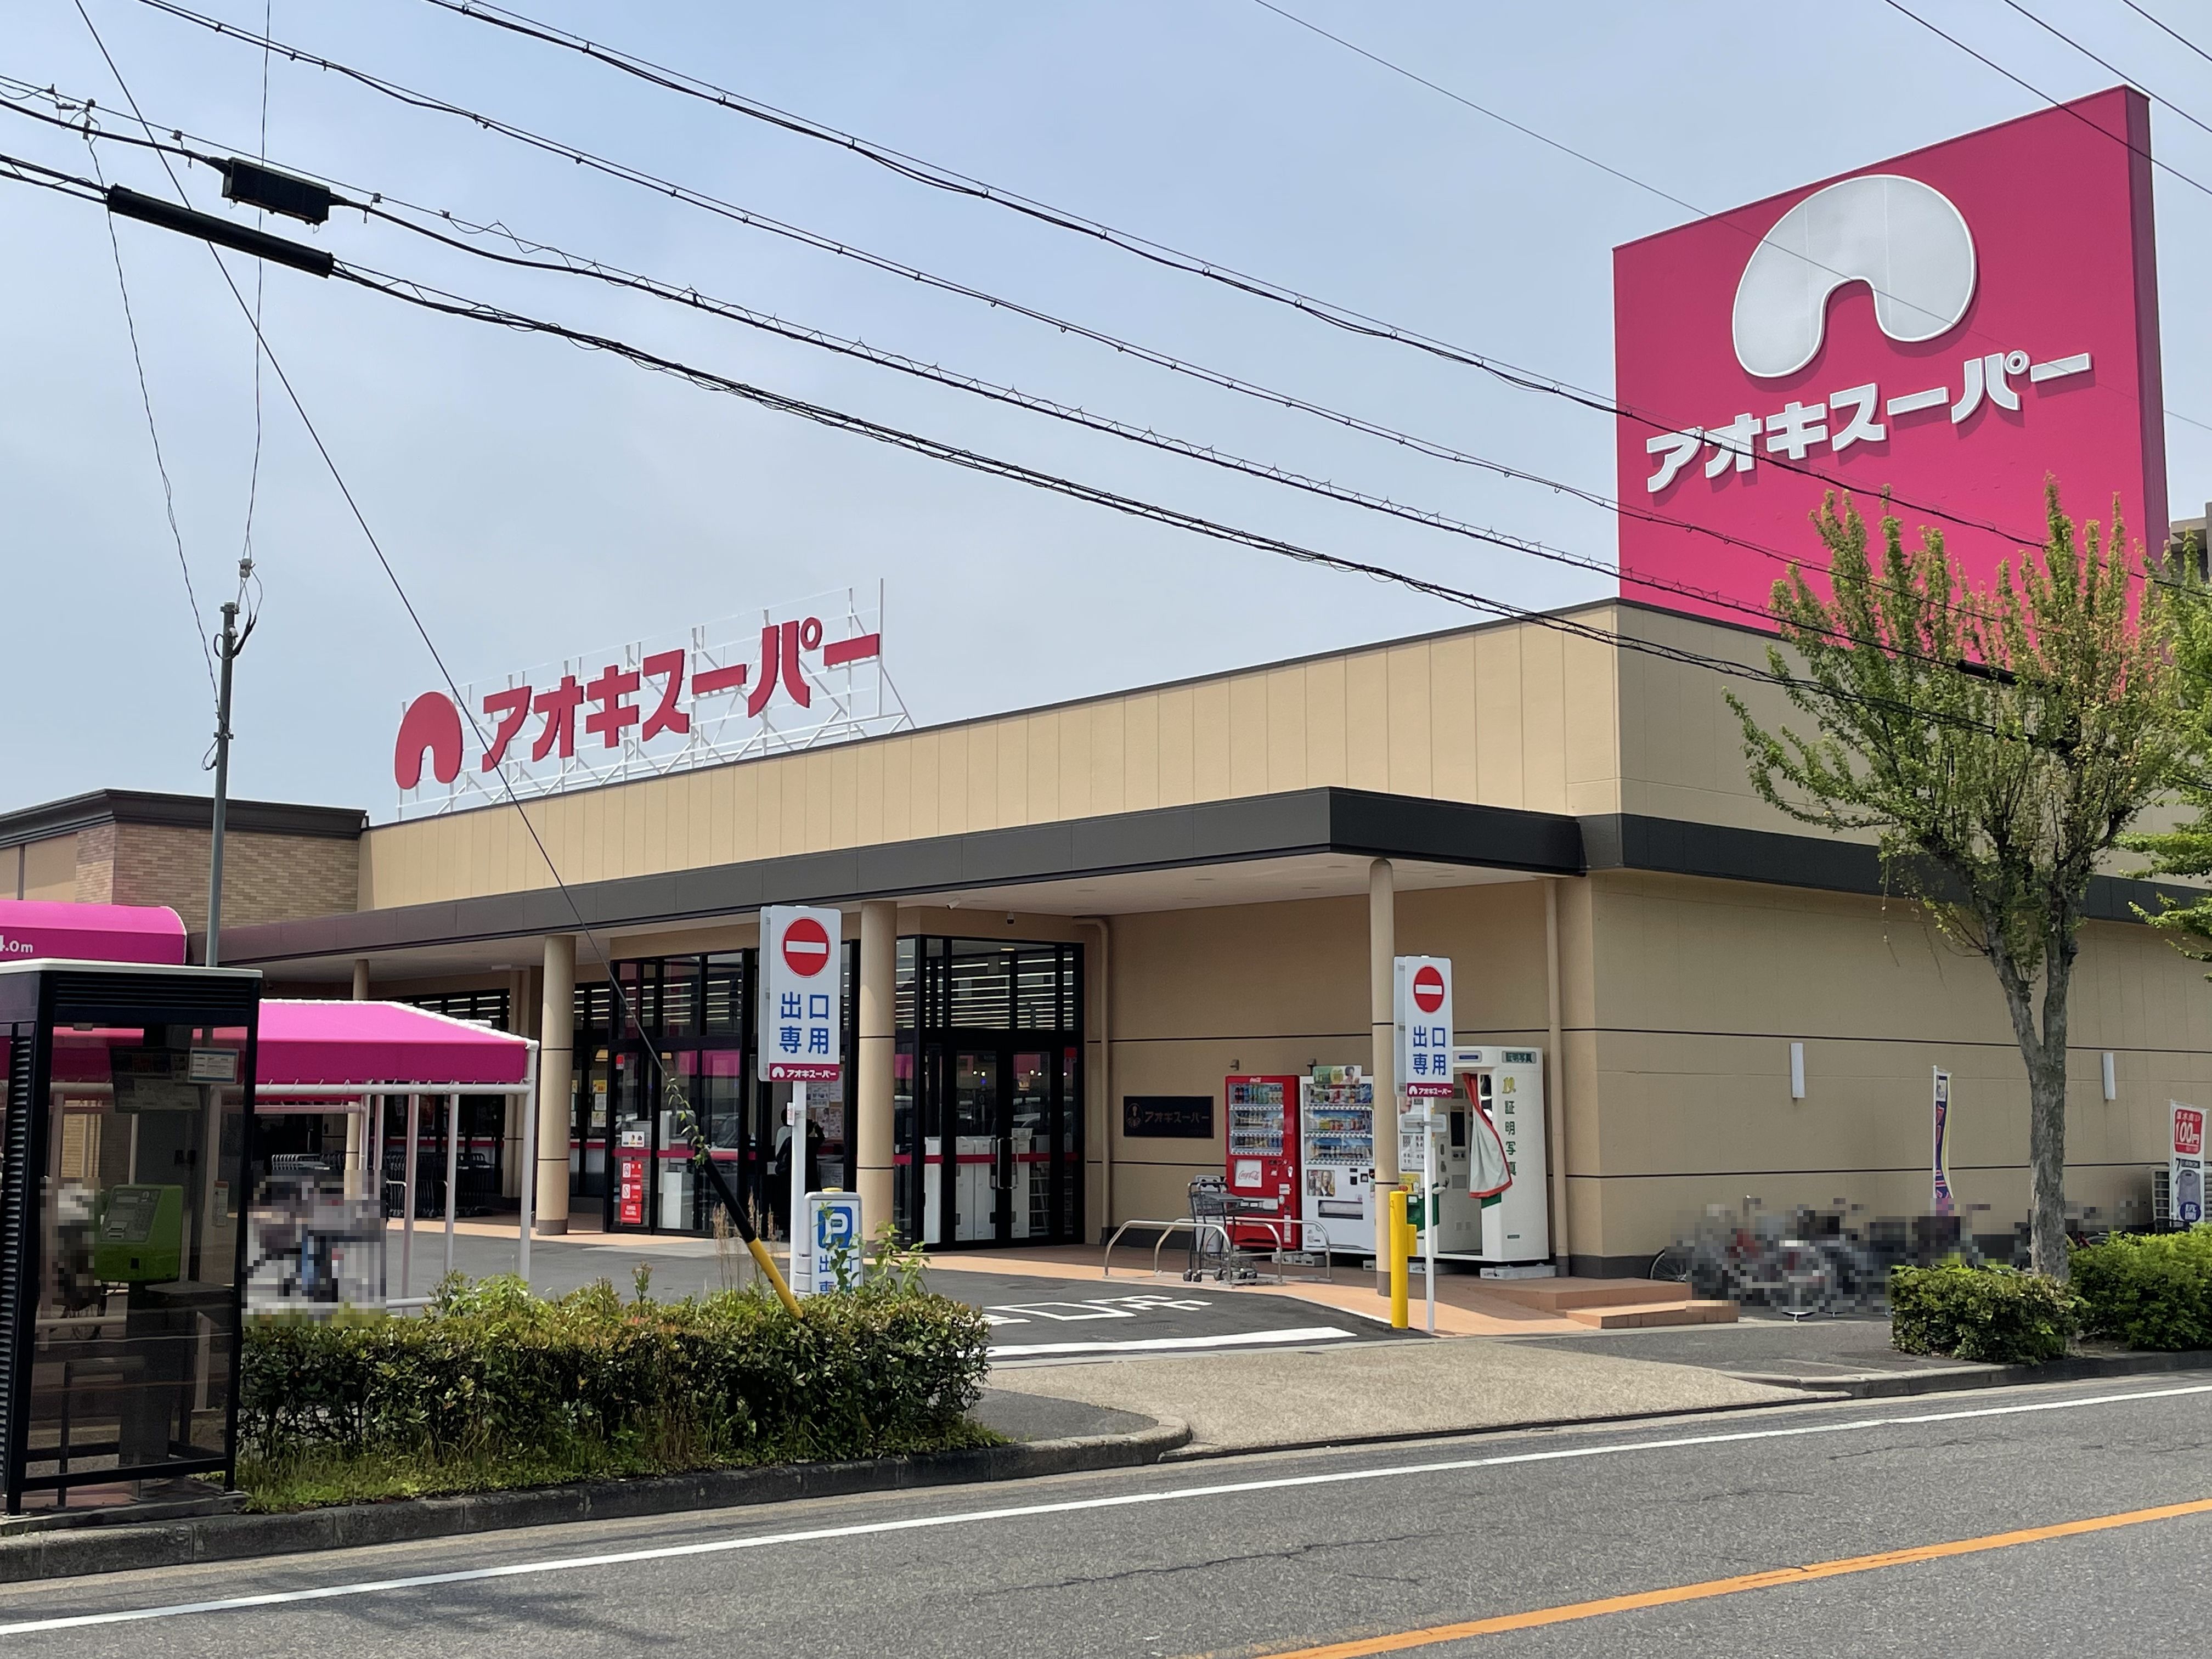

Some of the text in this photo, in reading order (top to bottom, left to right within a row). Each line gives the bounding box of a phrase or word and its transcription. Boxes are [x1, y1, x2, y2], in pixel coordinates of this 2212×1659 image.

[1646, 349, 2092, 493] アオキスーパー
[482, 617, 879, 773] アオキスーパー
[781, 992, 829, 1019] 出口
[779, 1026, 829, 1054] 専用
[1413, 1025, 1446, 1048] 出口
[786, 1069, 836, 1079] アオキスーパー
[1413, 1053, 1446, 1075] 専用
